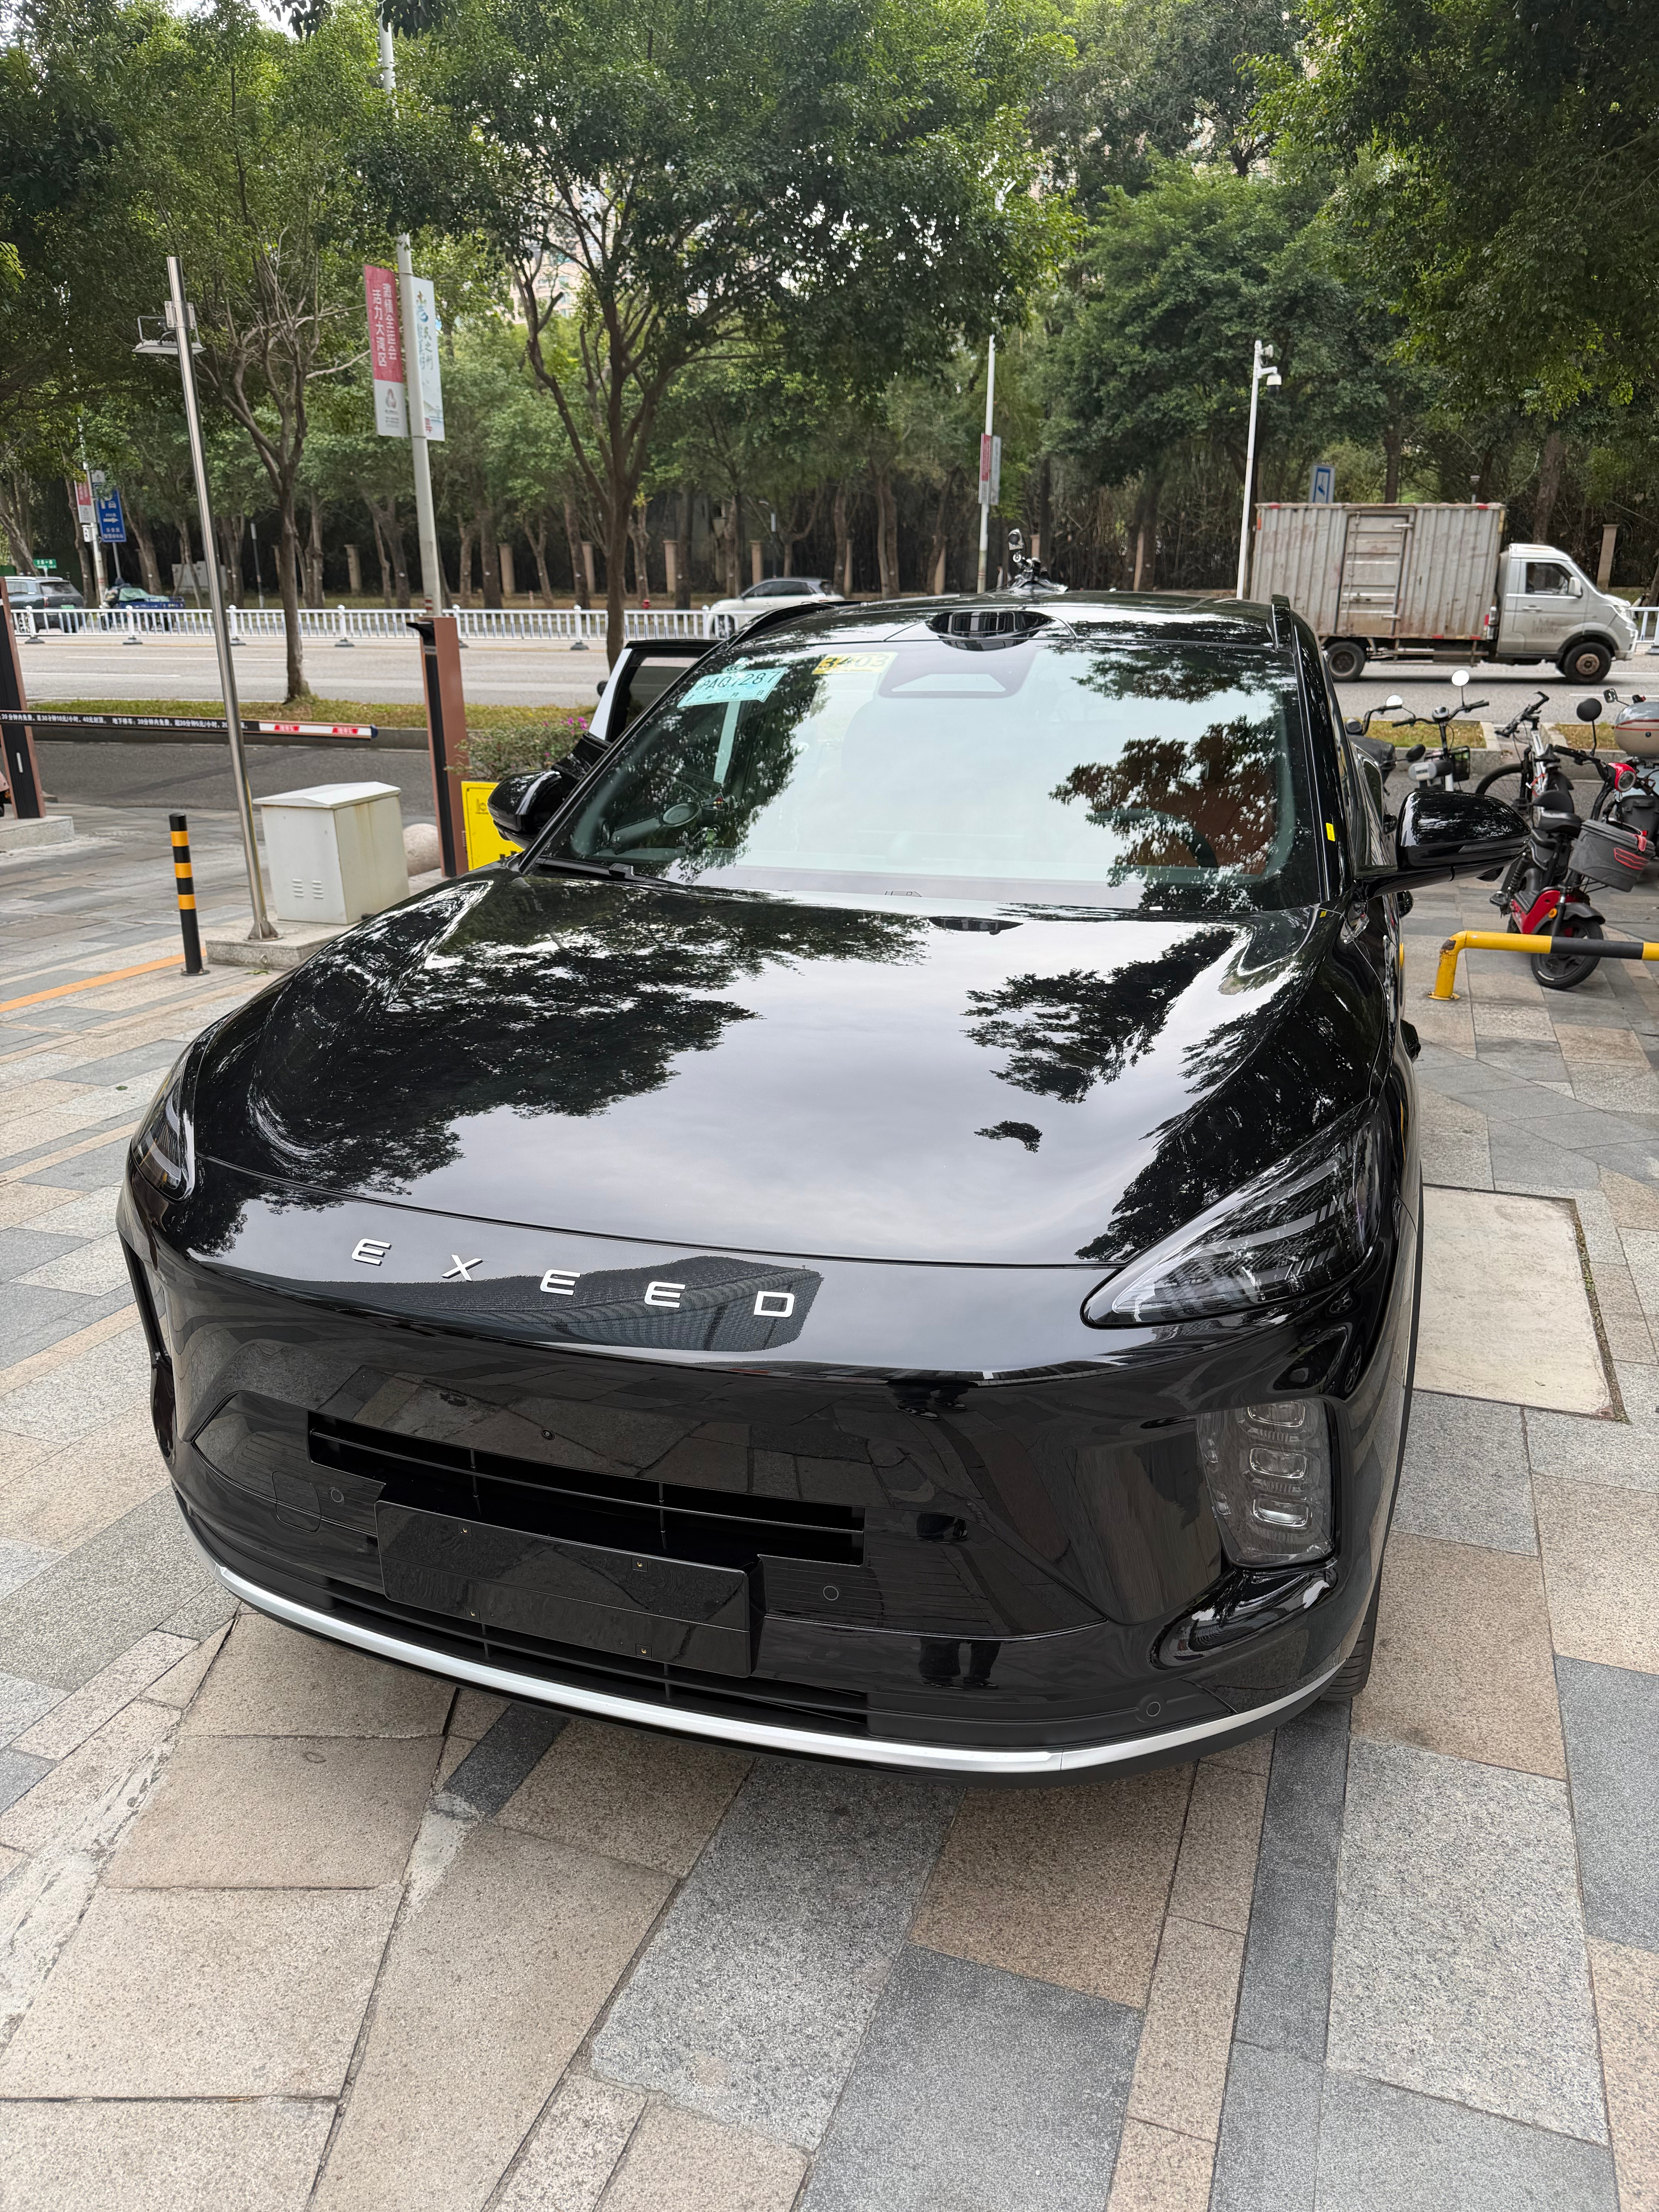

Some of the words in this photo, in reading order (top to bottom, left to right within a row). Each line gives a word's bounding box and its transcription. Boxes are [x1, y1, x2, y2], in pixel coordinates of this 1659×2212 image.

[372, 289, 387, 367] 活力大湾区
[351, 1238, 795, 1318] EXEED
